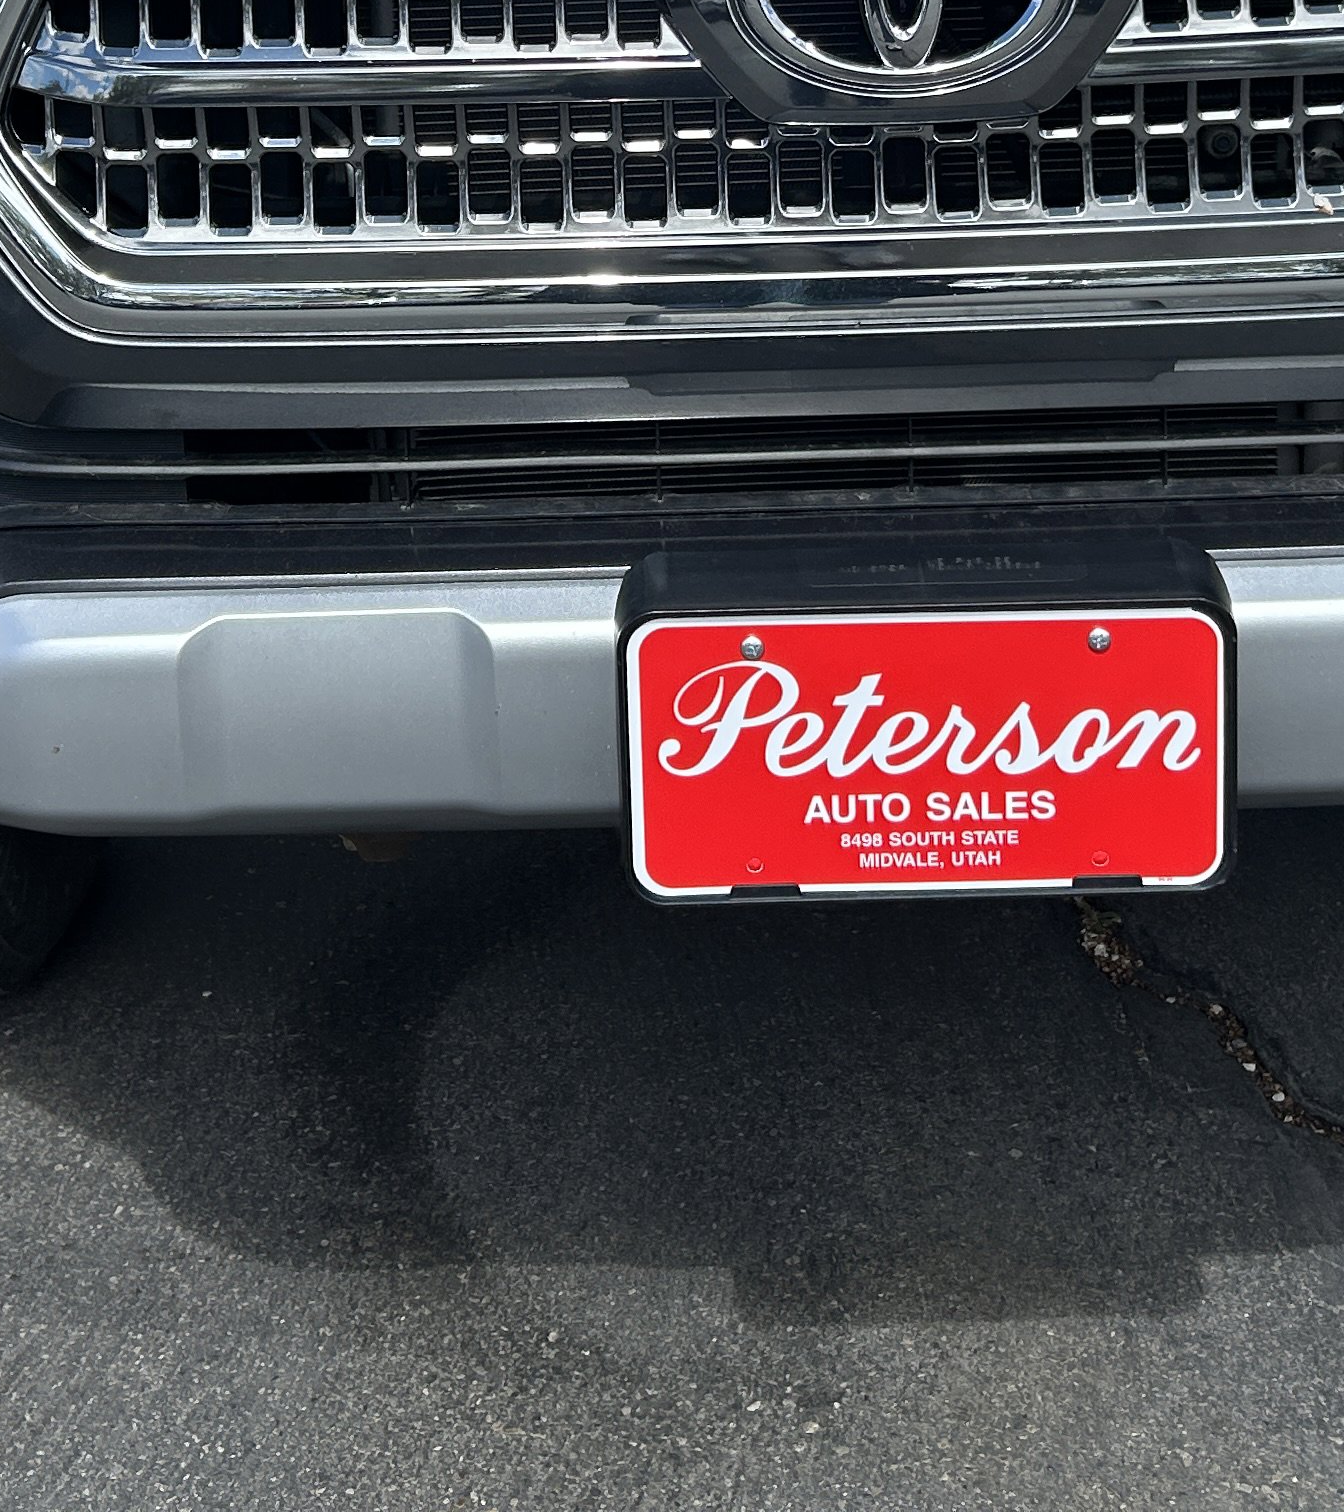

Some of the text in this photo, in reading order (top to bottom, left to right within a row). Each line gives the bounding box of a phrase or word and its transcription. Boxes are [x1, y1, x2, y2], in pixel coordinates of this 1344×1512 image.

[658, 659, 1201, 778] Peterson
[803, 790, 1056, 824] AUTO SALES
[840, 829, 1019, 848] 8498 SOUTH STATE
[859, 849, 1001, 869] MIDVALE, UTAH
